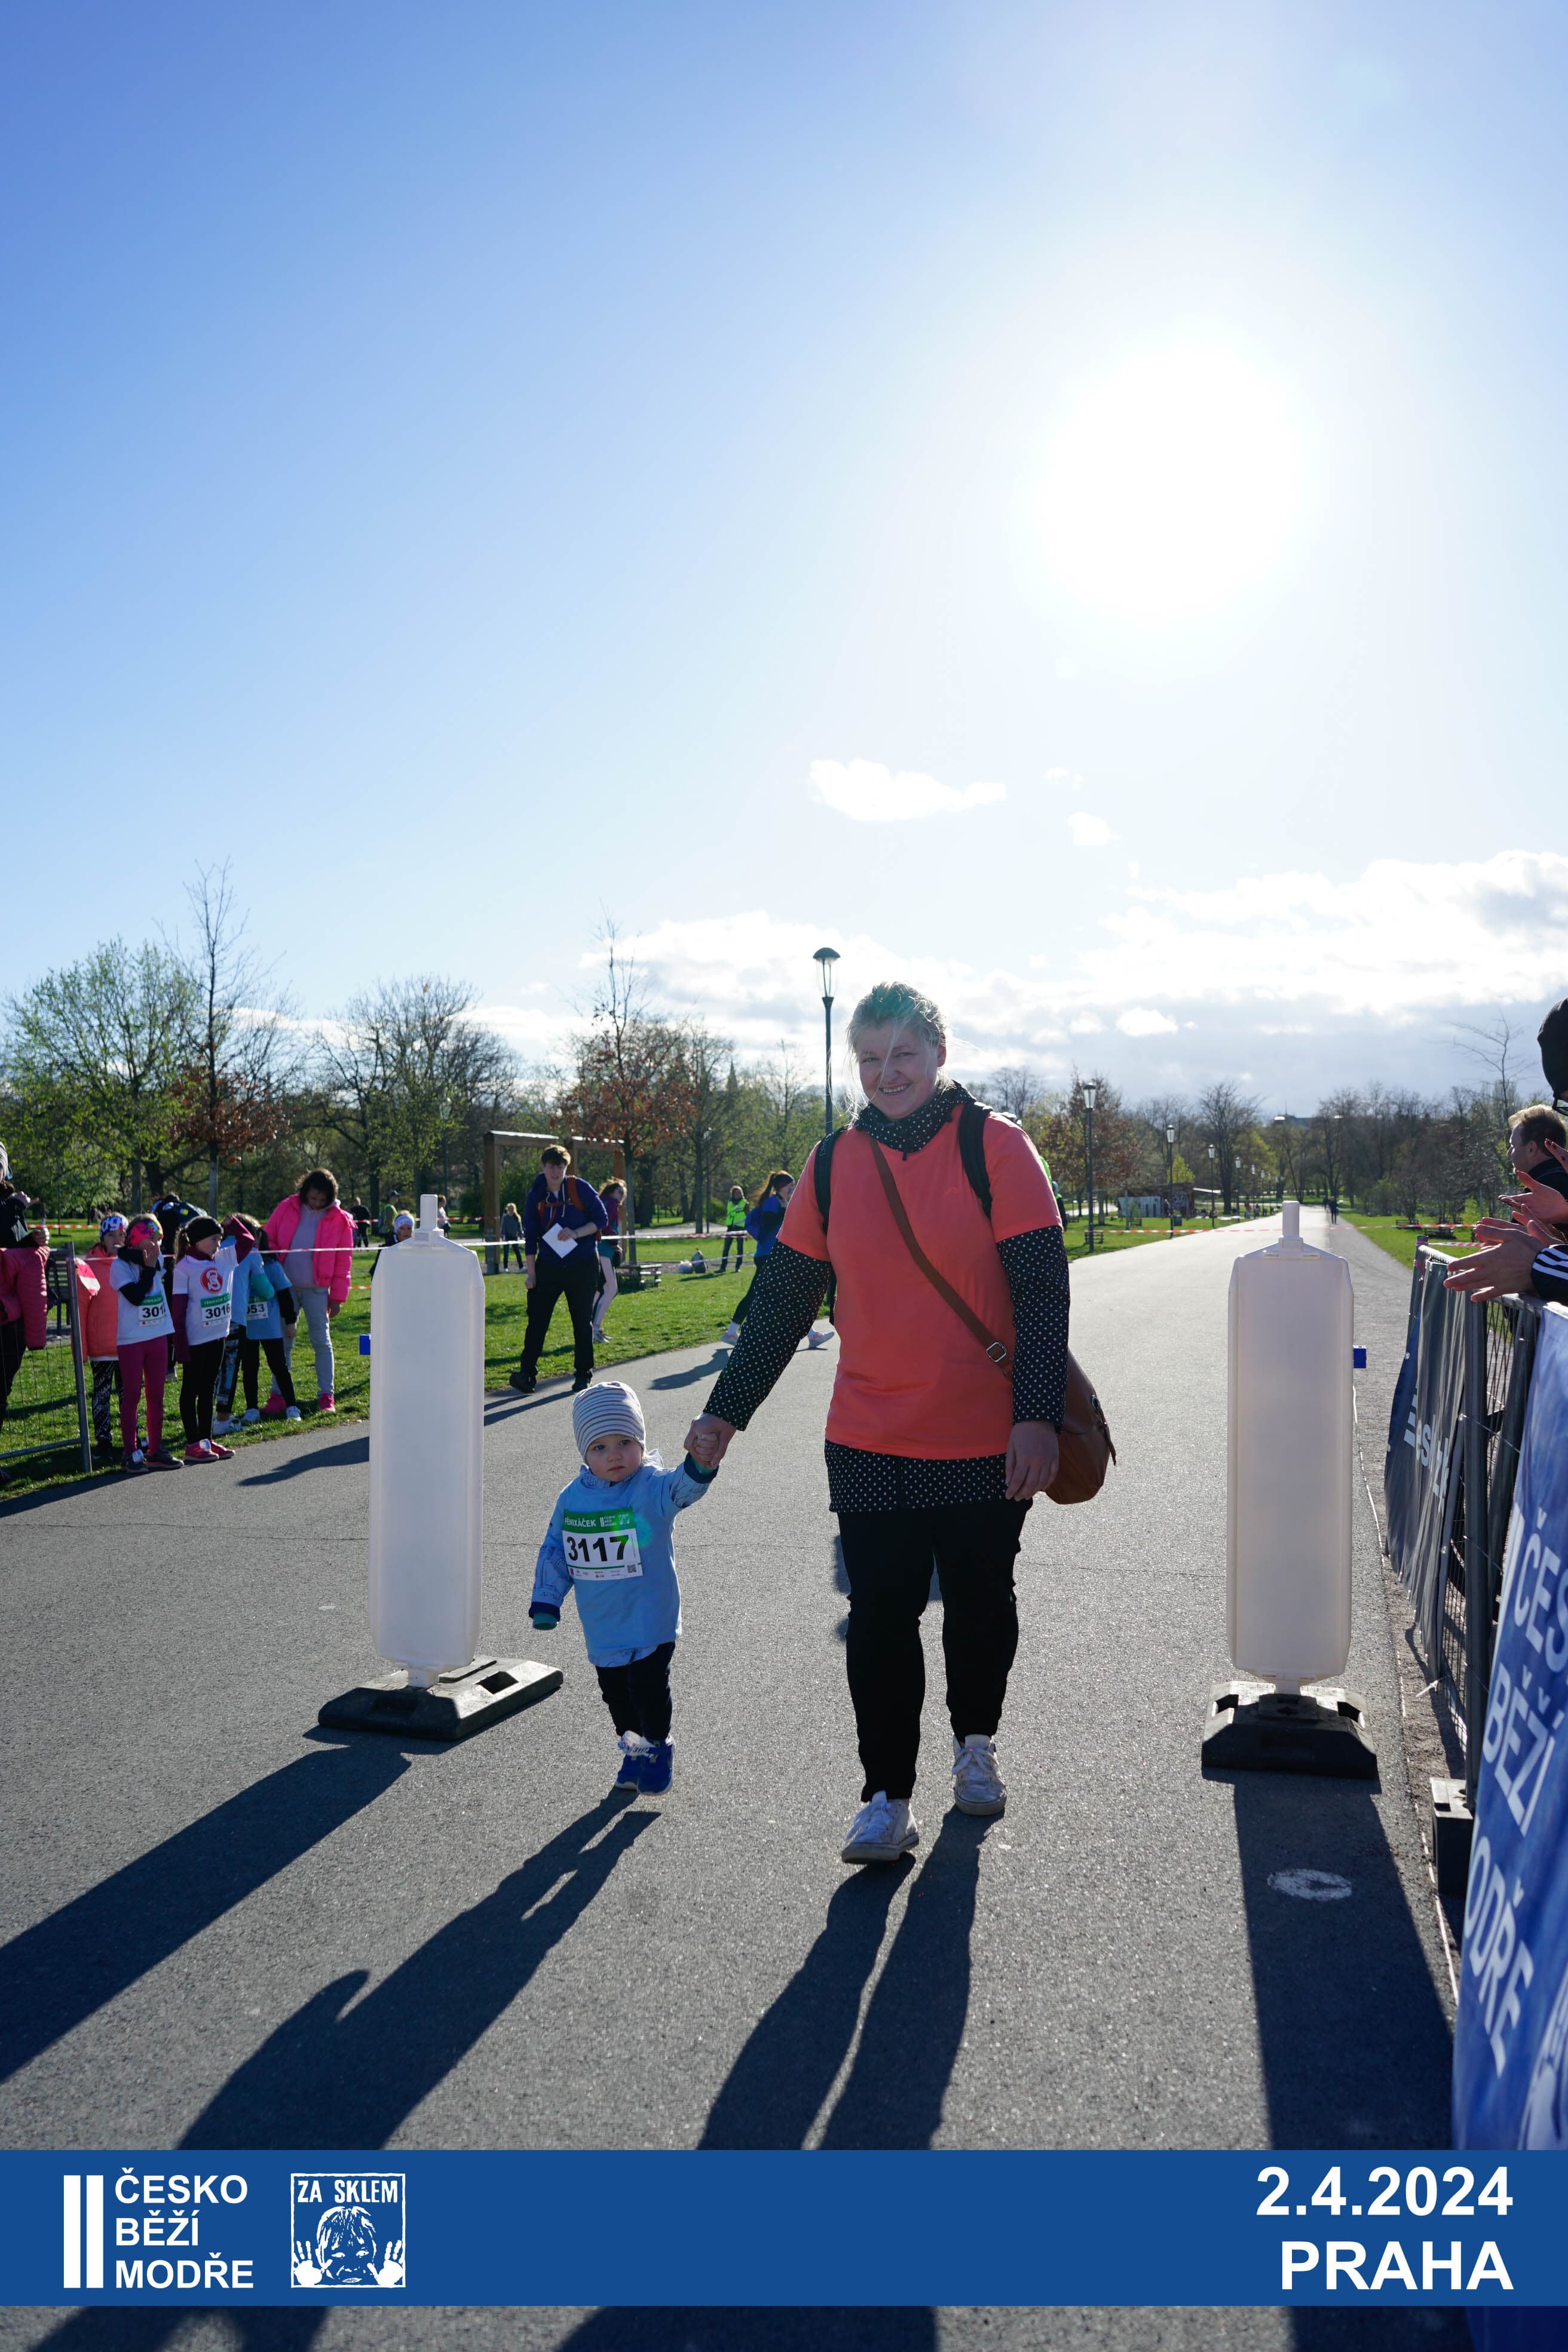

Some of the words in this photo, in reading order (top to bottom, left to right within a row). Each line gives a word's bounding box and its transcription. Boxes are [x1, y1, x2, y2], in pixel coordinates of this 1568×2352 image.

[205, 1304, 230, 1319] 3016
[565, 1516, 597, 1527] FÉNIXÁČEK
[566, 1535, 629, 1562] 3117
[1482, 1661, 1565, 1838] BĚŽÍ
[1464, 1817, 1534, 2079] ODŘE
